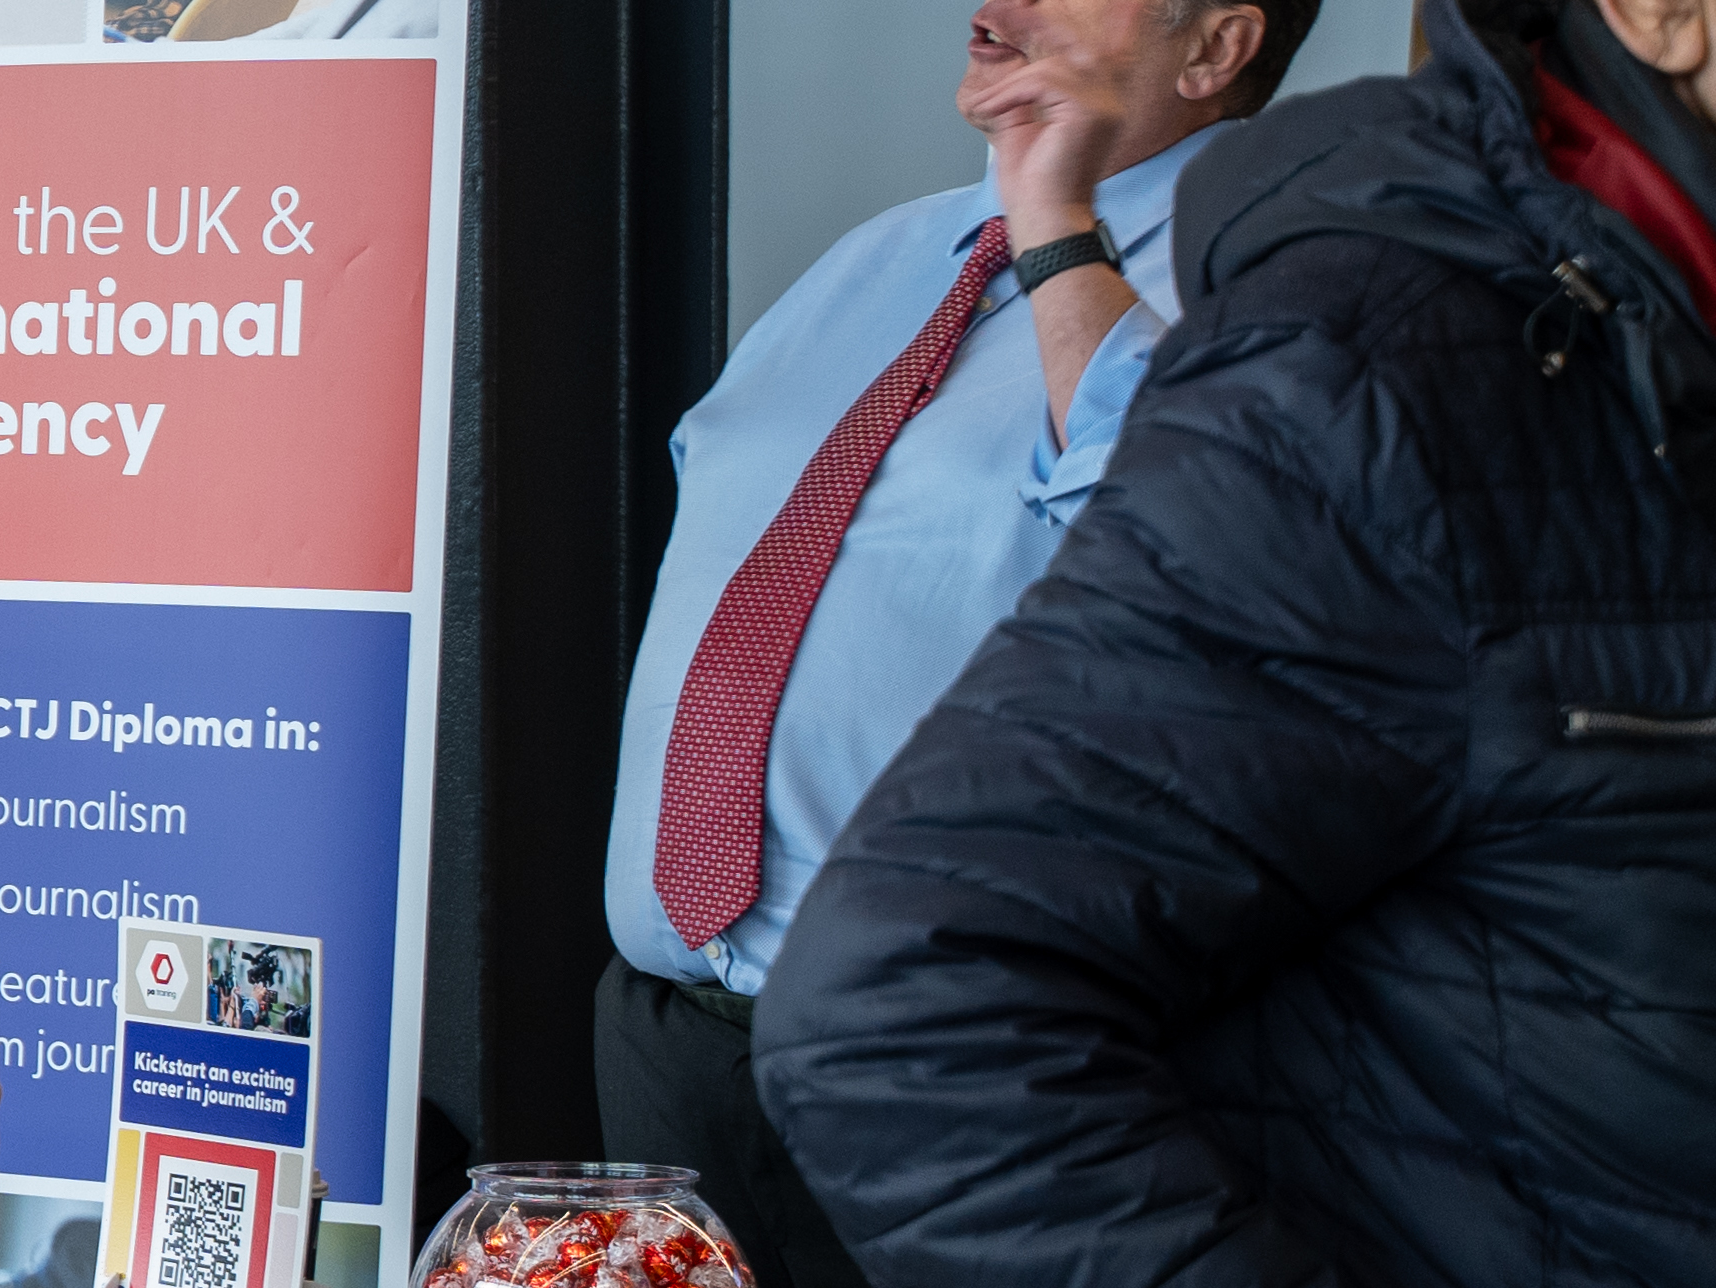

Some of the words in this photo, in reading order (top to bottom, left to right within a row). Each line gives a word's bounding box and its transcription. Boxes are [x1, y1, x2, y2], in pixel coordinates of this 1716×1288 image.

[13, 186, 123, 256] the
[146, 185, 241, 256] UK
[261, 185, 315, 256] &
[69, 700, 252, 754] Diploma
[264, 706, 322, 752] in:
[146, 988, 155, 997] pa
[132, 1078, 184, 1100] career
[186, 1080, 201, 1101] in
[201, 1087, 288, 1114] journalism
[134, 1051, 207, 1080] Kickstart
[208, 1066, 228, 1082] an
[232, 1067, 296, 1096] exciting
